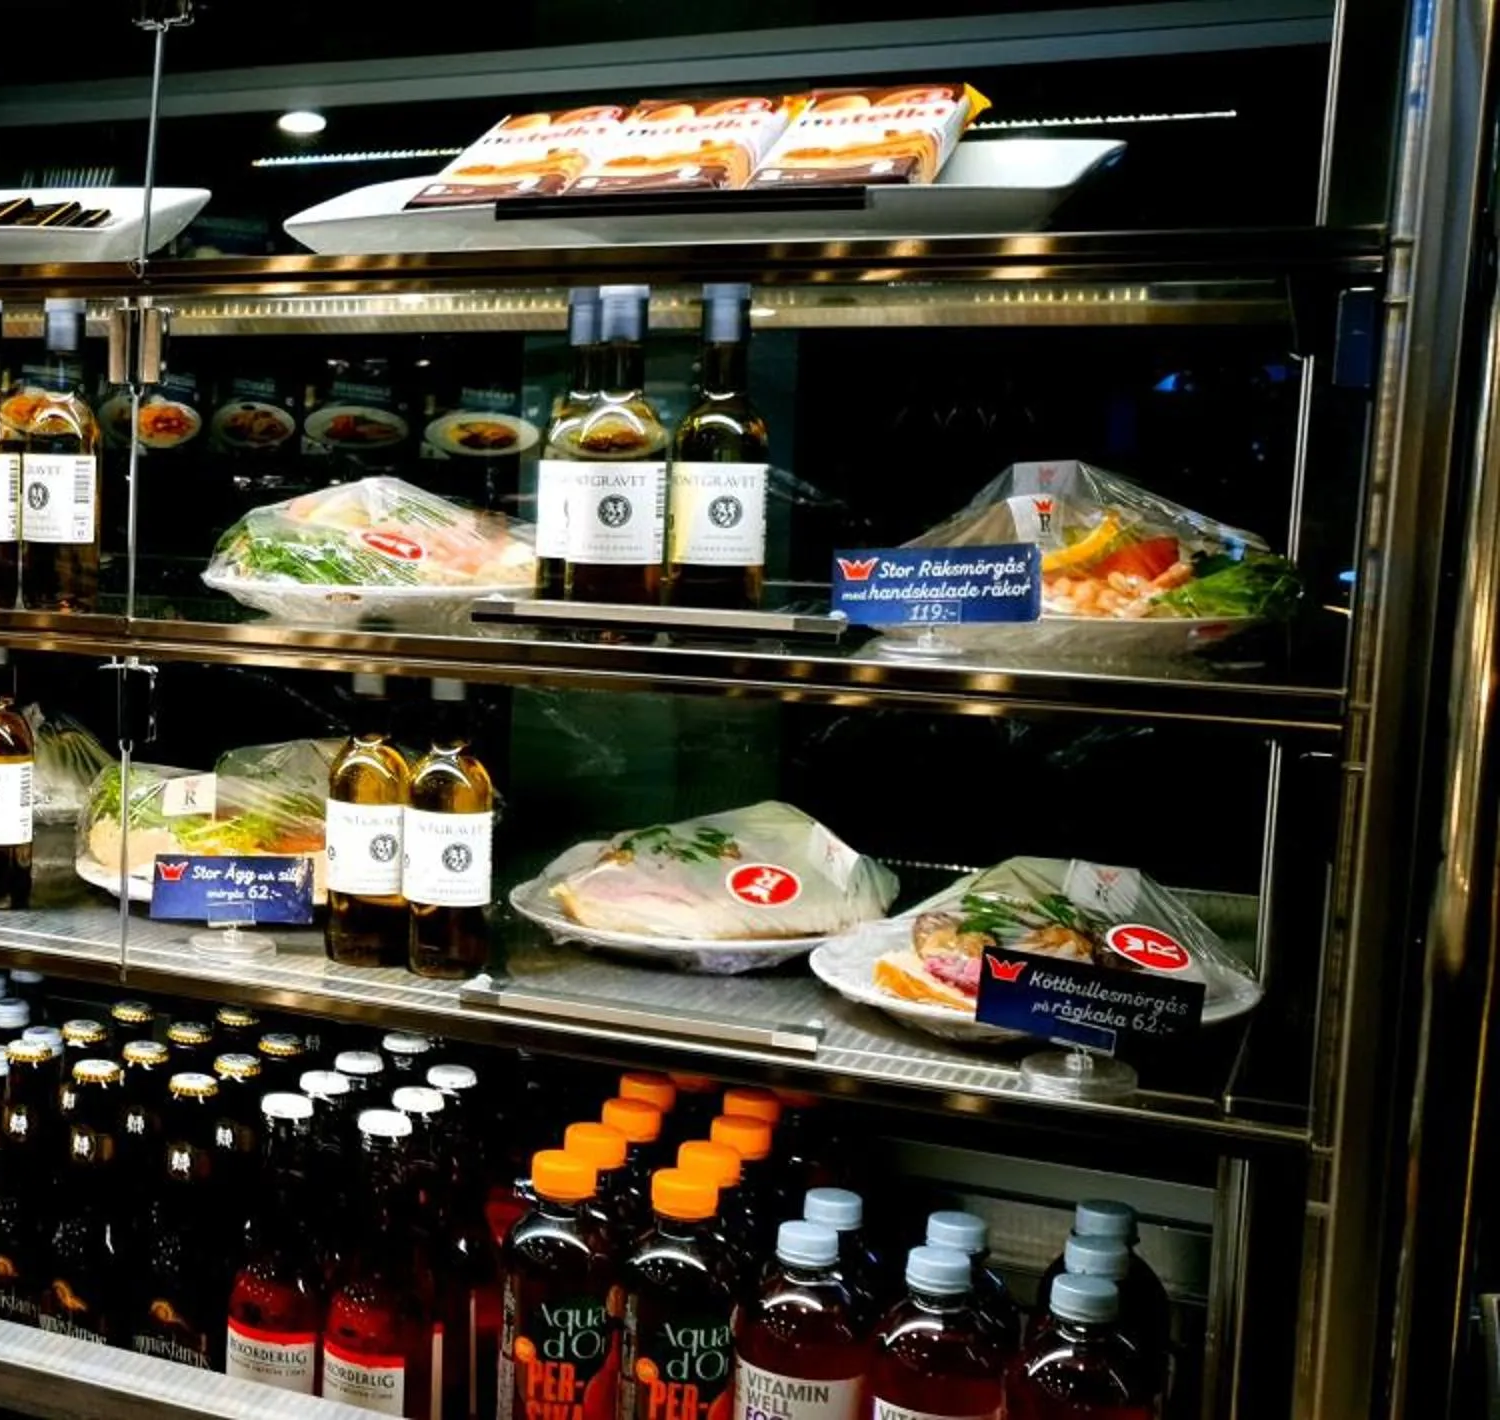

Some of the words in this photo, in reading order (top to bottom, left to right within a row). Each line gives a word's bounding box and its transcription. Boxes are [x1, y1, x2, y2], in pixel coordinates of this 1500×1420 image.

[879, 560, 914, 579] Stor
[918, 556, 1027, 580] Räksmörgås
[841, 589, 867, 600] med
[867, 581, 980, 601] handskalade
[982, 579, 1031, 597] räkor
[909, 603, 957, 621] 119:-
[191, 865, 222, 880] Stor
[224, 861, 255, 885] Ägg
[257, 871, 276, 881] och
[248, 885, 282, 900] 62:-
[1028, 970, 1190, 1015] Köttbullesmörgås
[1030, 1000, 1049, 1014] på
[1051, 999, 1127, 1027] rågkaka
[1131, 1012, 1175, 1034] 62:-
[526, 1361, 585, 1402] PER-
[746, 1370, 830, 1404] VITAMIN
[746, 1388, 792, 1418] WELL
